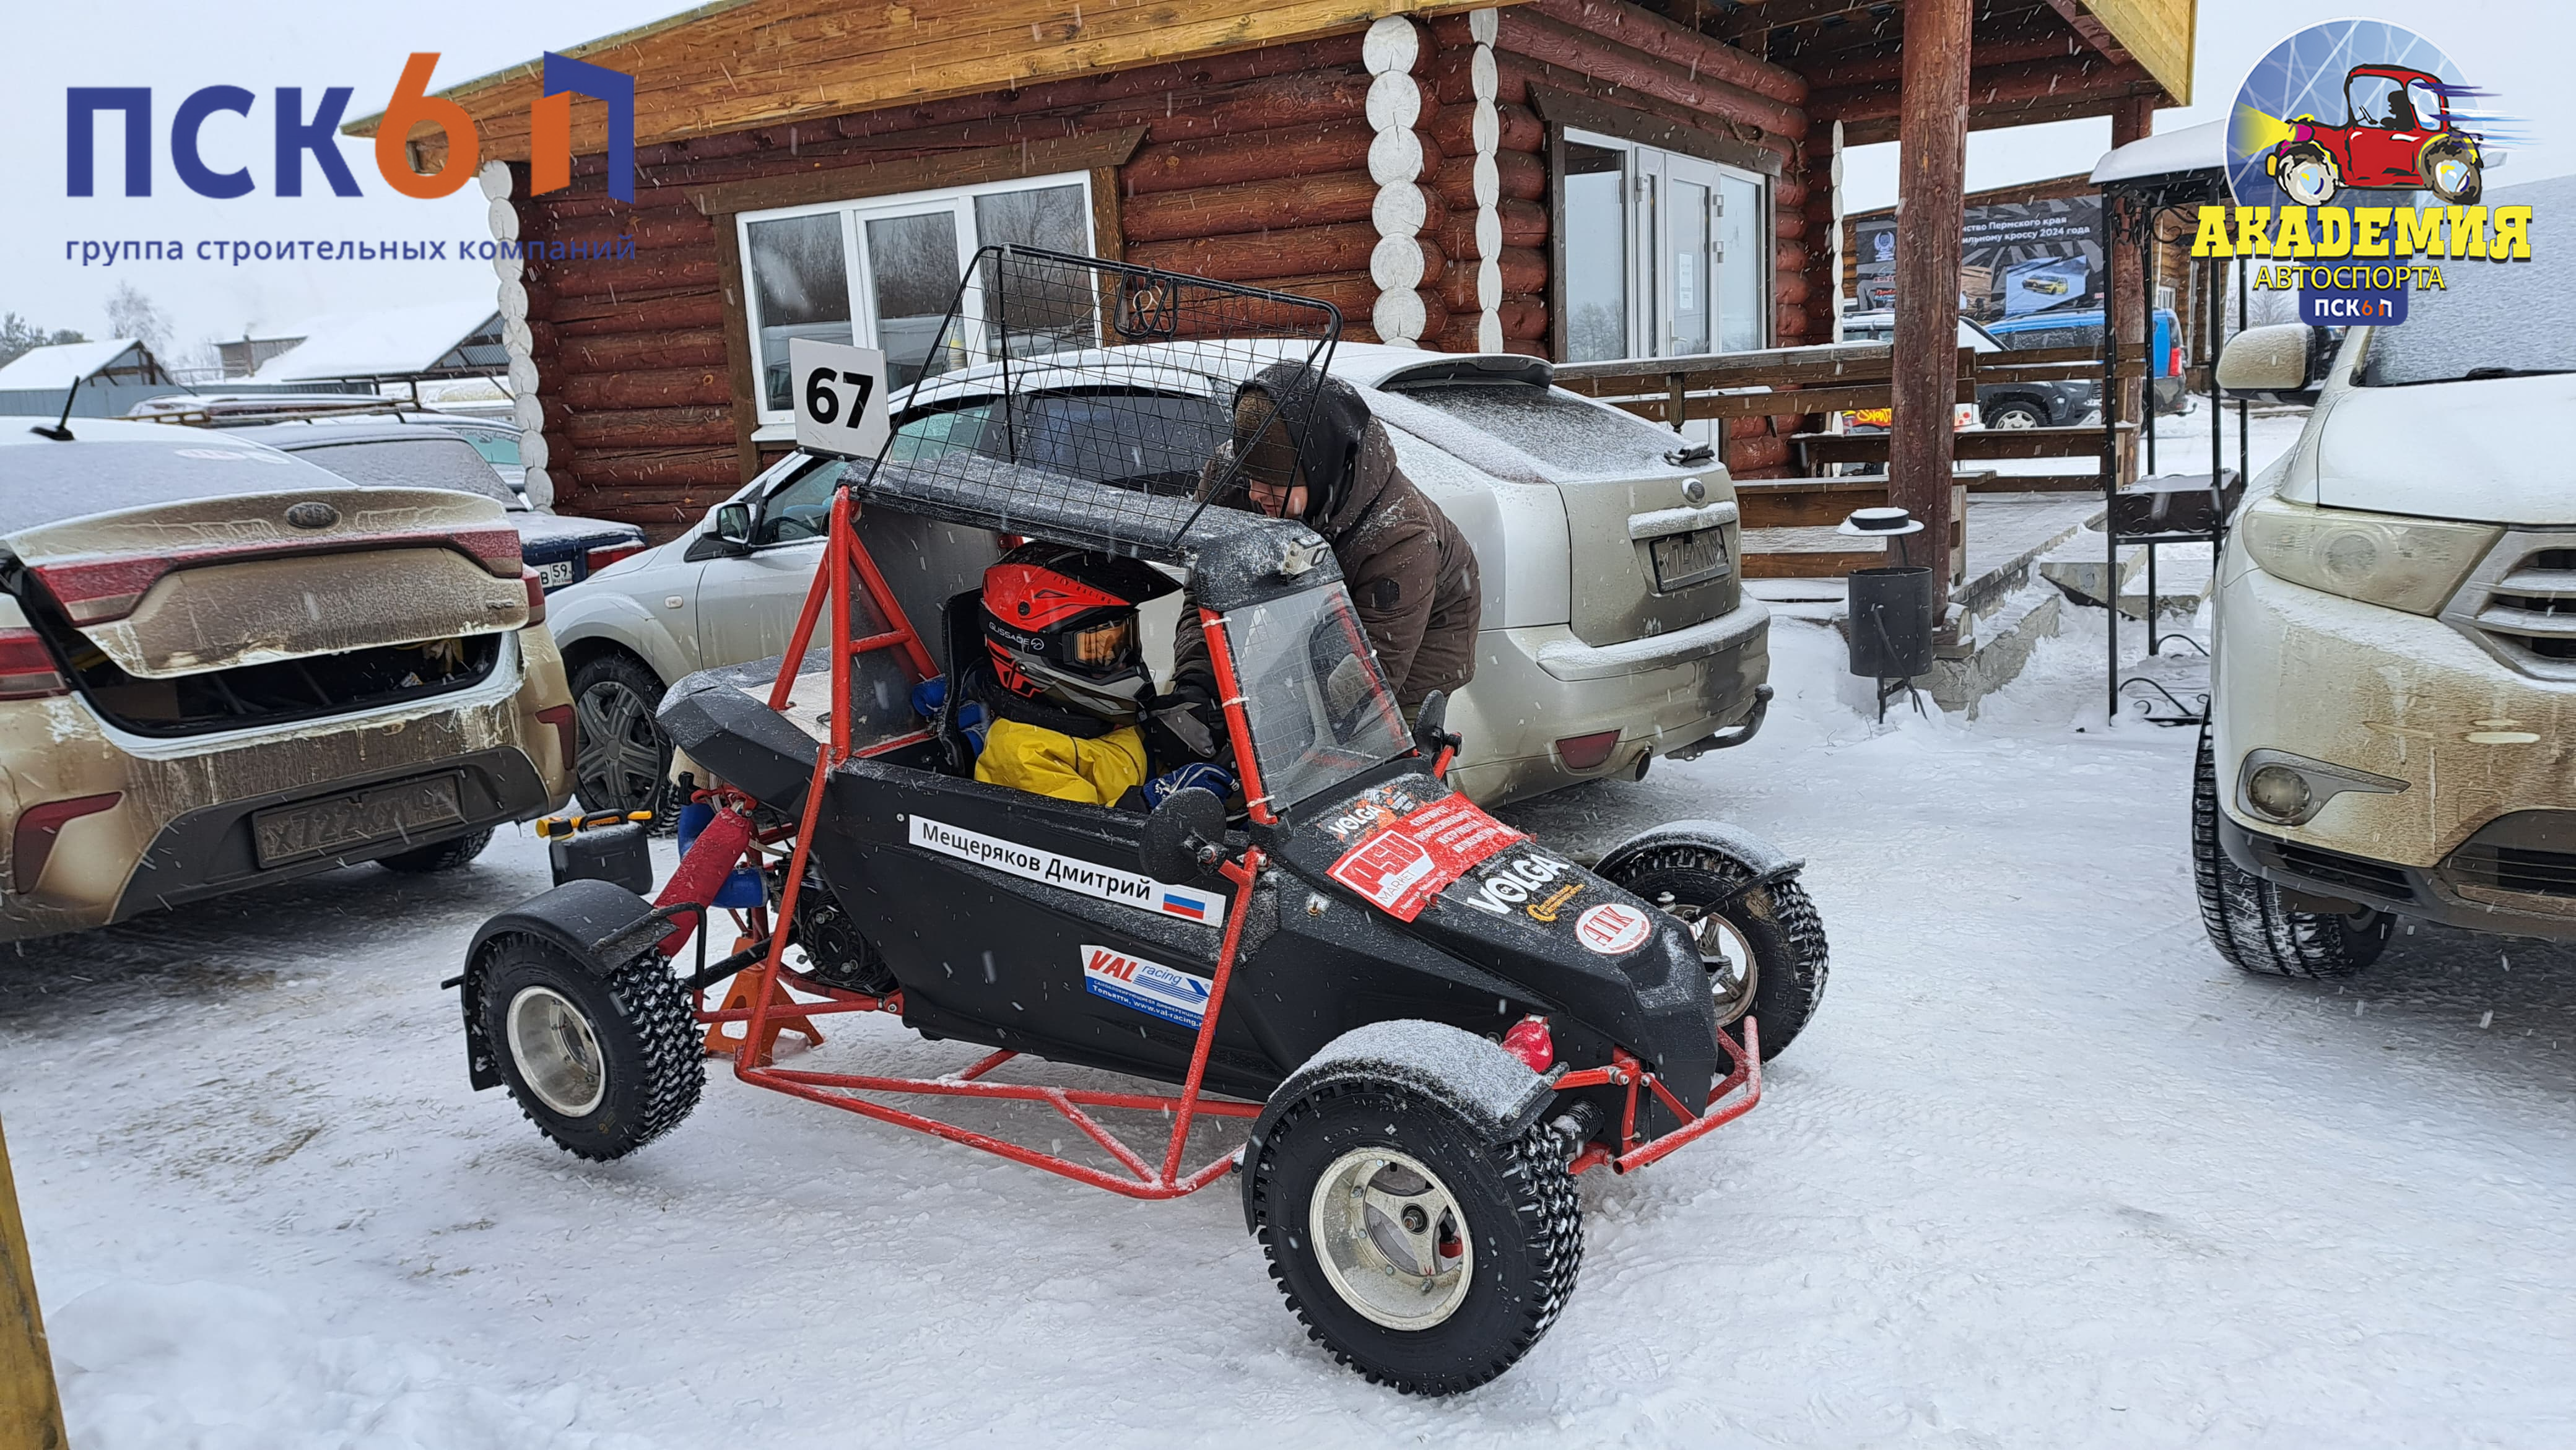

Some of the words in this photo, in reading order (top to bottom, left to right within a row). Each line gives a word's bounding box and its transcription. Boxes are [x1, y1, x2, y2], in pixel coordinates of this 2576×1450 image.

[1989, 220, 2041, 230] Пермского
[2043, 216, 2067, 227] края
[2004, 231, 2039, 241] кроссу
[2040, 227, 2064, 238] 2024
[2066, 225, 2091, 235] года
[806, 367, 874, 430] 67
[552, 564, 567, 578] 59
[1328, 804, 1386, 835] VOLGA
[923, 822, 1040, 871] Мещеряков
[1045, 857, 1151, 901] Дмитрий
[1377, 869, 1416, 903] MARKET
[1467, 853, 1570, 914] VOLGA
[1089, 950, 1138, 983] VAL
[1142, 965, 1182, 985] racing
